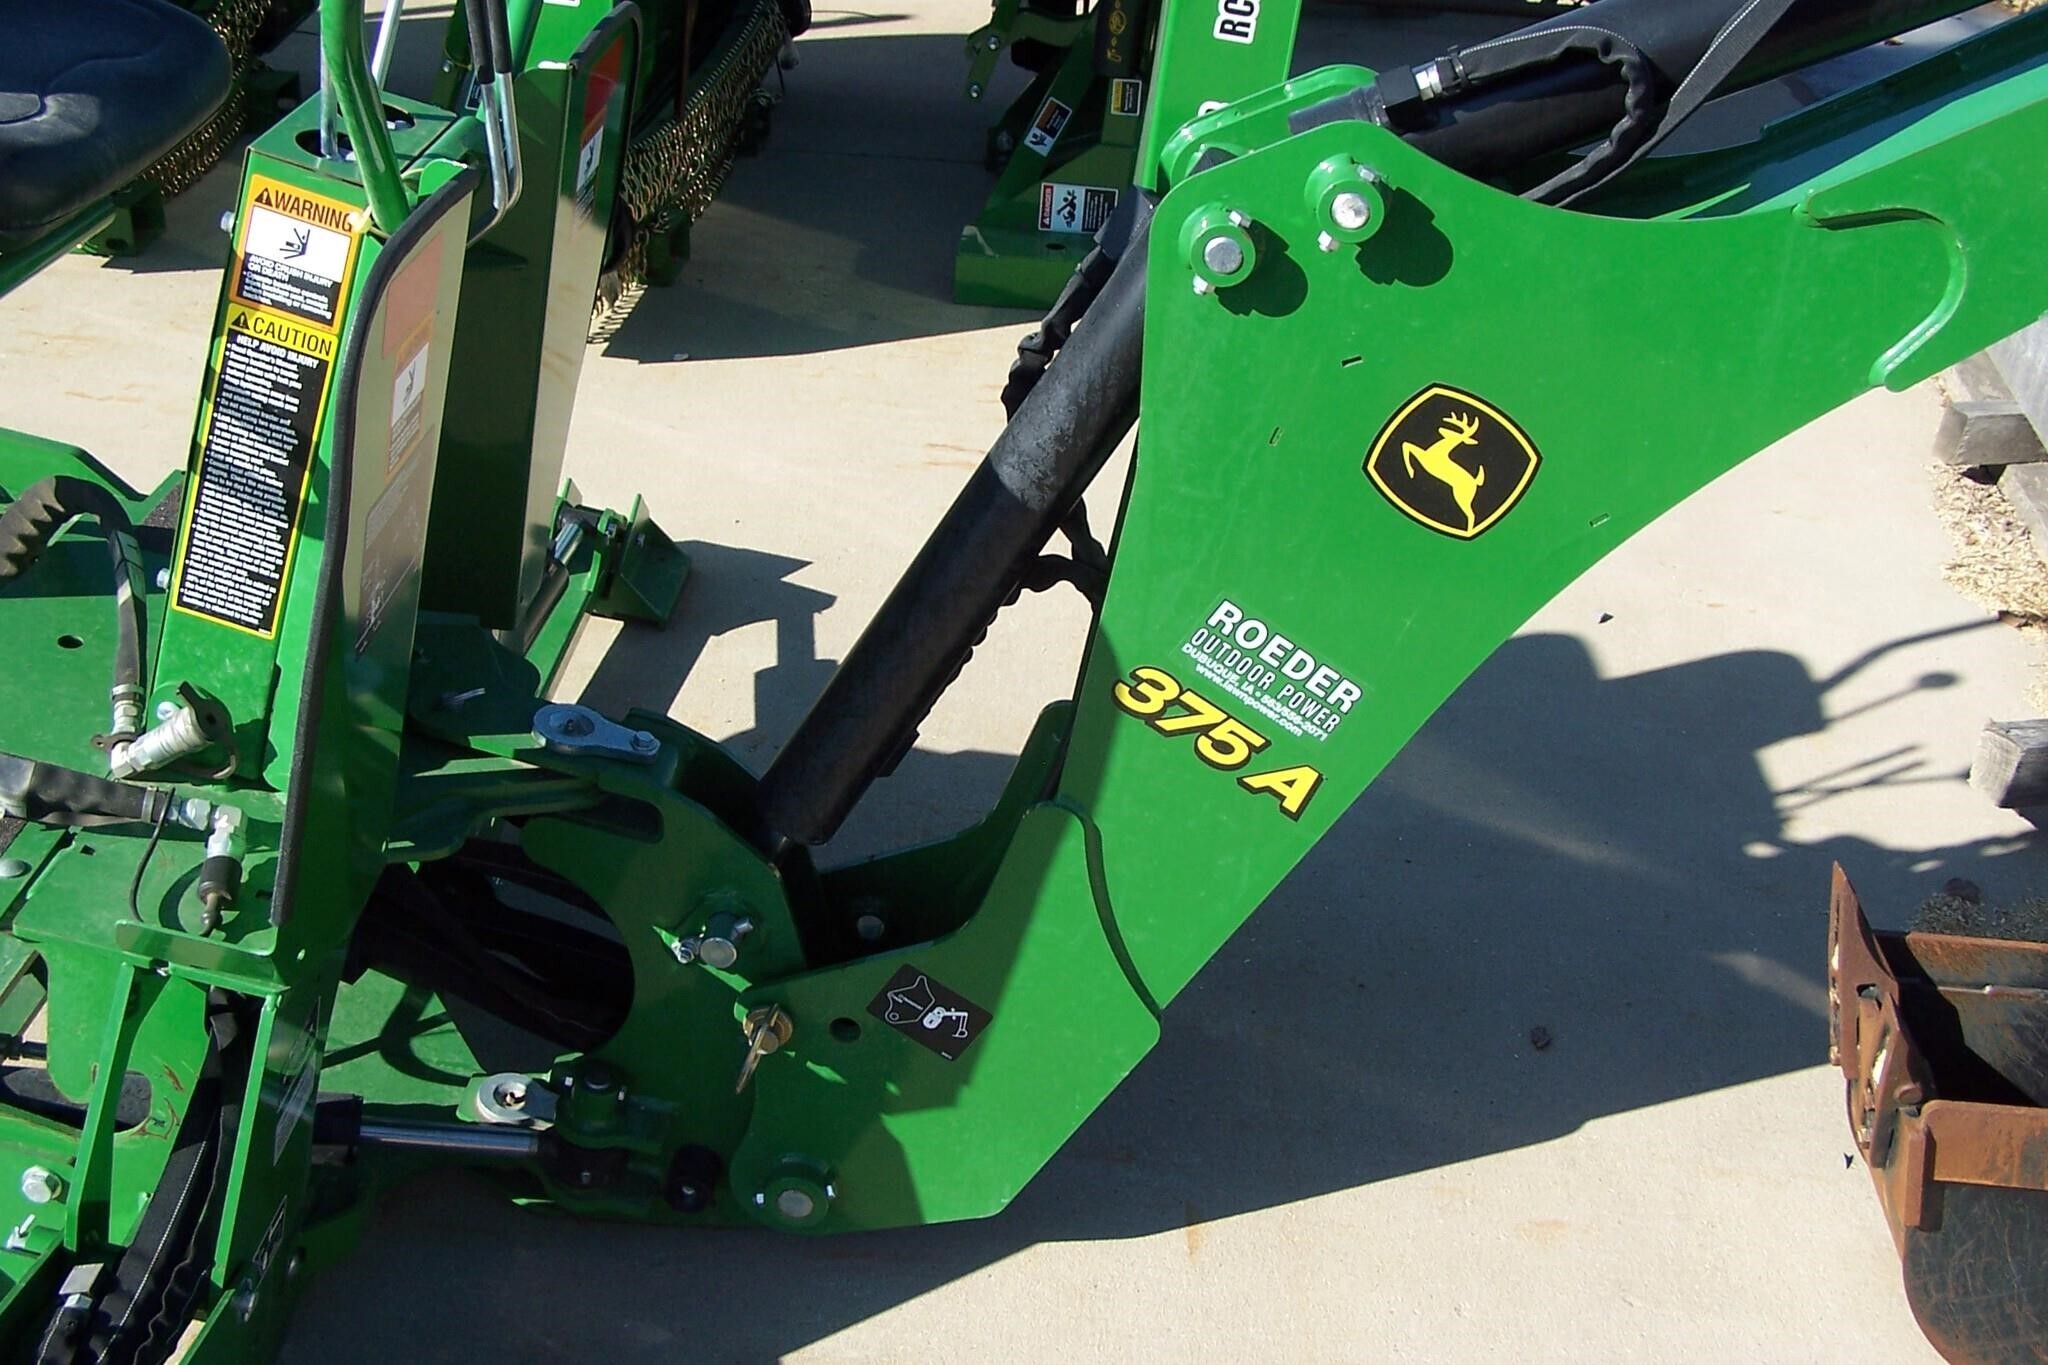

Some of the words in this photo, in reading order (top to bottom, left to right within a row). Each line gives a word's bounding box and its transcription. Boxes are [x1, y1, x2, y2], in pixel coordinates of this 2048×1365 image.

[272, 189, 355, 233] WARNING
[236, 334, 259, 349] HELP
[259, 341, 286, 358] AVOID
[286, 350, 319, 368] INJURY
[252, 315, 333, 356] CAUTION
[1181, 642, 1240, 688] DUBUQUE,
[1242, 680, 1256, 696] IA
[1190, 628, 1276, 694] OUTDOOR
[1277, 683, 1342, 734] POWER
[1206, 598, 1363, 716] ROEDER
[1196, 663, 1303, 737] www.lawnpower.com
